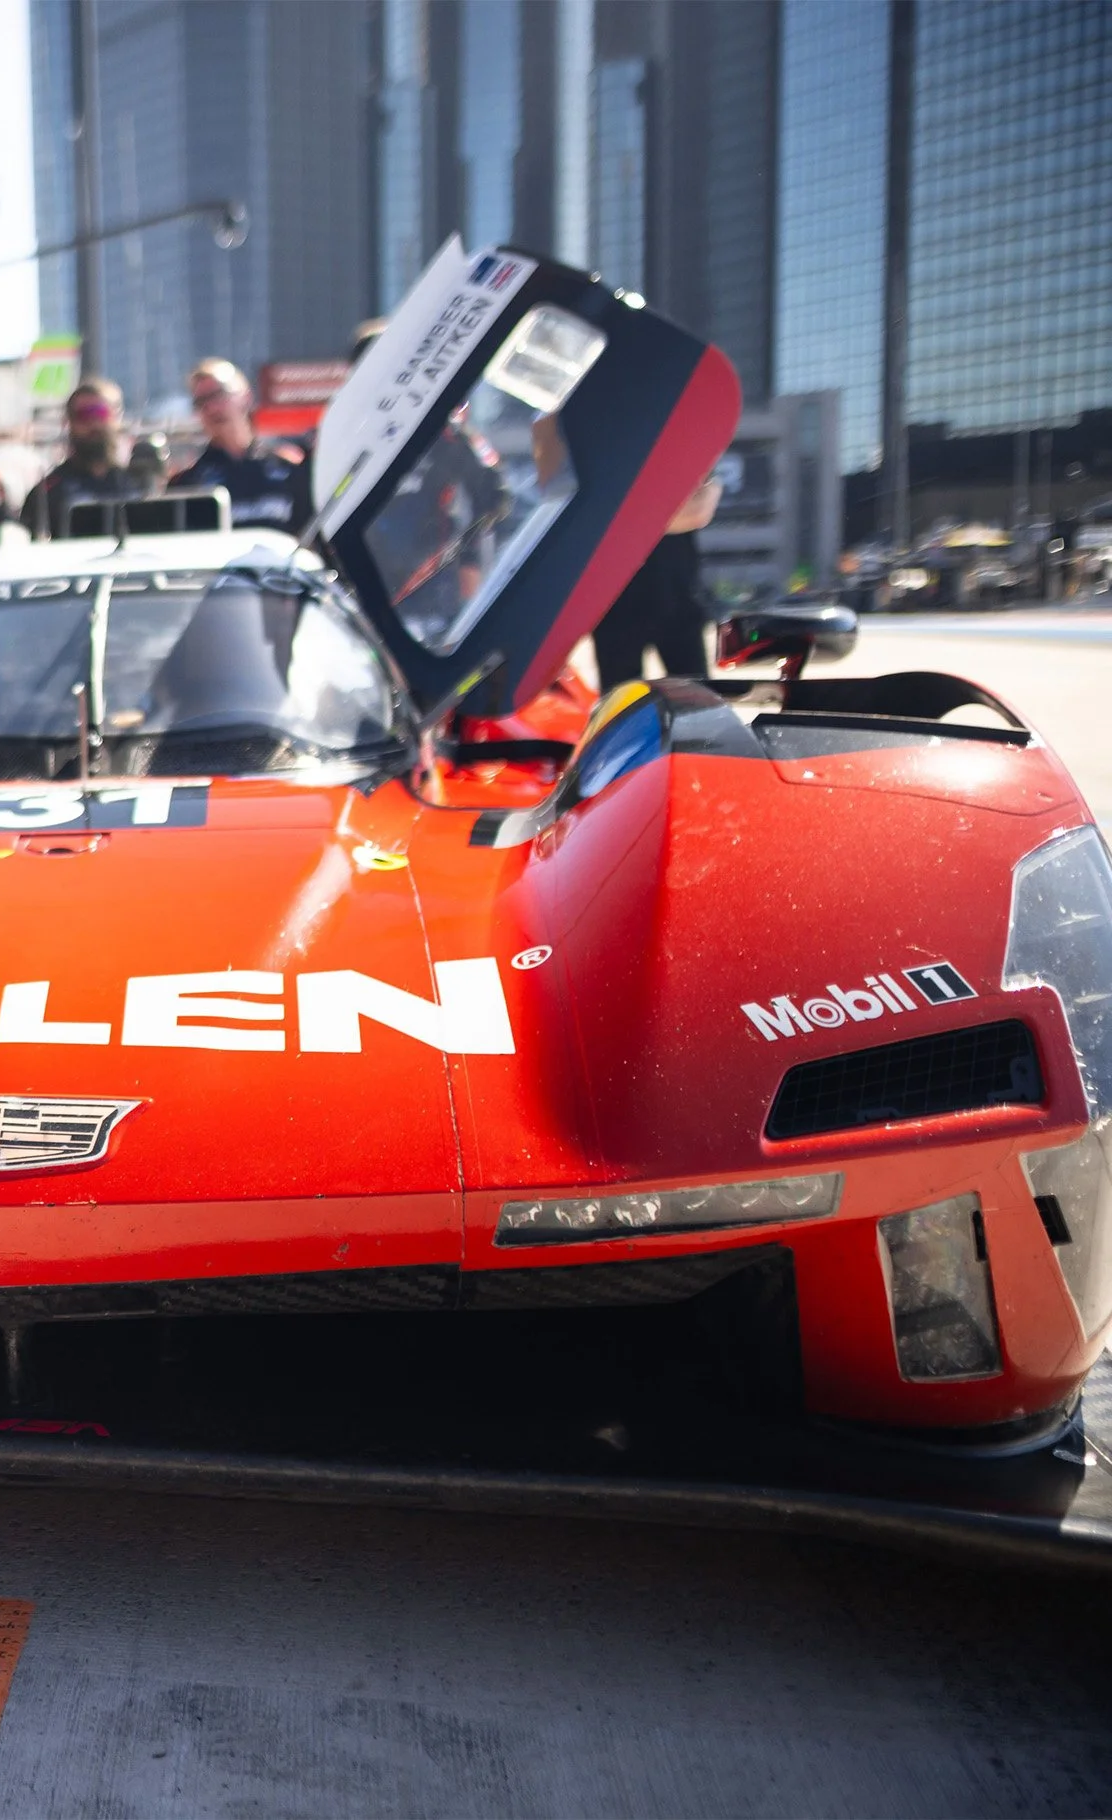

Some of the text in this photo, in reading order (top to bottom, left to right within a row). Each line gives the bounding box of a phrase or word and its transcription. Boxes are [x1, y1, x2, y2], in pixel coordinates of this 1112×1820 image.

[395, 294, 471, 386] BAMBER
[423, 297, 494, 380] AITKEN
[739, 973, 919, 1042] Mobil
